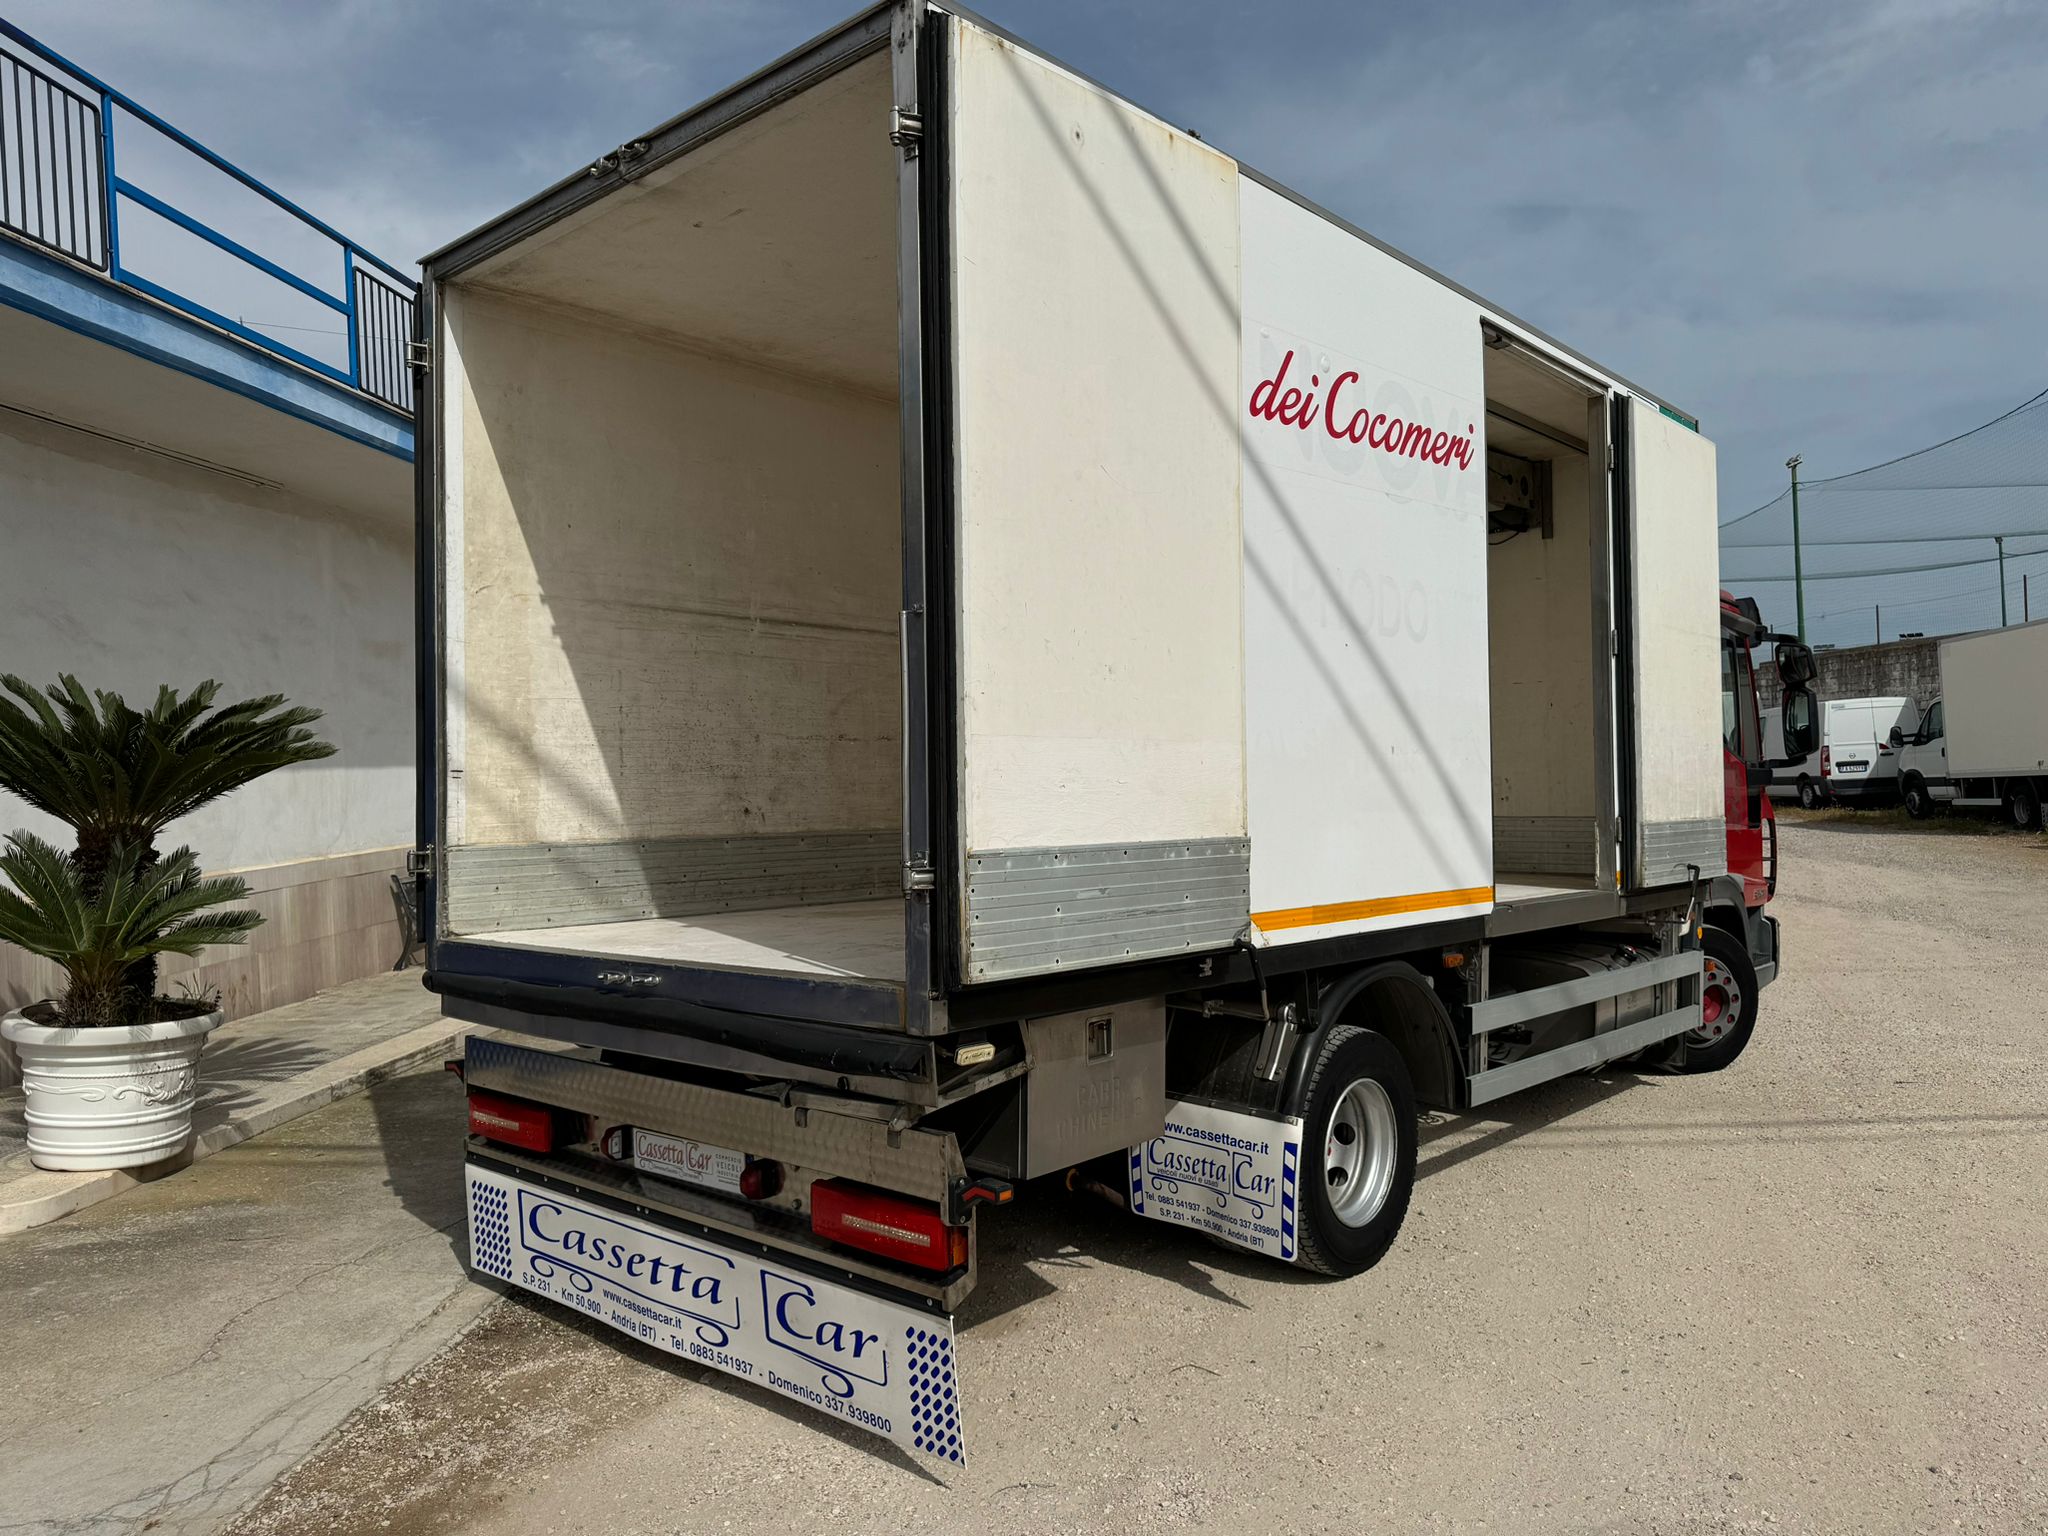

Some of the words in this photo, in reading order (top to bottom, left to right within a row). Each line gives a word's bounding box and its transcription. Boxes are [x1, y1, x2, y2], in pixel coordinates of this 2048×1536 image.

[1250, 350, 1320, 430] dei
[1325, 371, 1475, 471] Cocomeri
[638, 1135, 684, 1165] Cassetta
[688, 1145, 712, 1171] Car
[1165, 1122, 1269, 1155] ww.cassettacar.it
[1150, 1138, 1226, 1182] Cassetta
[1236, 1161, 1275, 1194] Car
[1145, 1191, 1156, 1201] Tel.
[1158, 1195, 1175, 1206] 0883
[1175, 1199, 1200, 1212] 541937
[1206, 1206, 1238, 1225] Domenico
[1173, 1212, 1185, 1221] 231
[1191, 1216, 1202, 1226] Km
[1227, 1228, 1248, 1242] Andria
[1250, 1235, 1264, 1249] (BT)
[529, 1203, 722, 1304] Cassetta
[775, 1291, 879, 1358] Car
[602, 1288, 682, 1329] www.cassettacar.it
[522, 1272, 536, 1287] S.P.
[538, 1278, 550, 1293] 231
[561, 1287, 575, 1304] Km
[611, 1310, 637, 1333] Andria
[638, 1321, 657, 1343] (BT)
[670, 1335, 687, 1353] Tel.
[690, 1342, 714, 1361] 0883
[717, 1352, 753, 1376] 541937
[769, 1371, 822, 1405] Domenico
[824, 1395, 892, 1433] 337.939800
